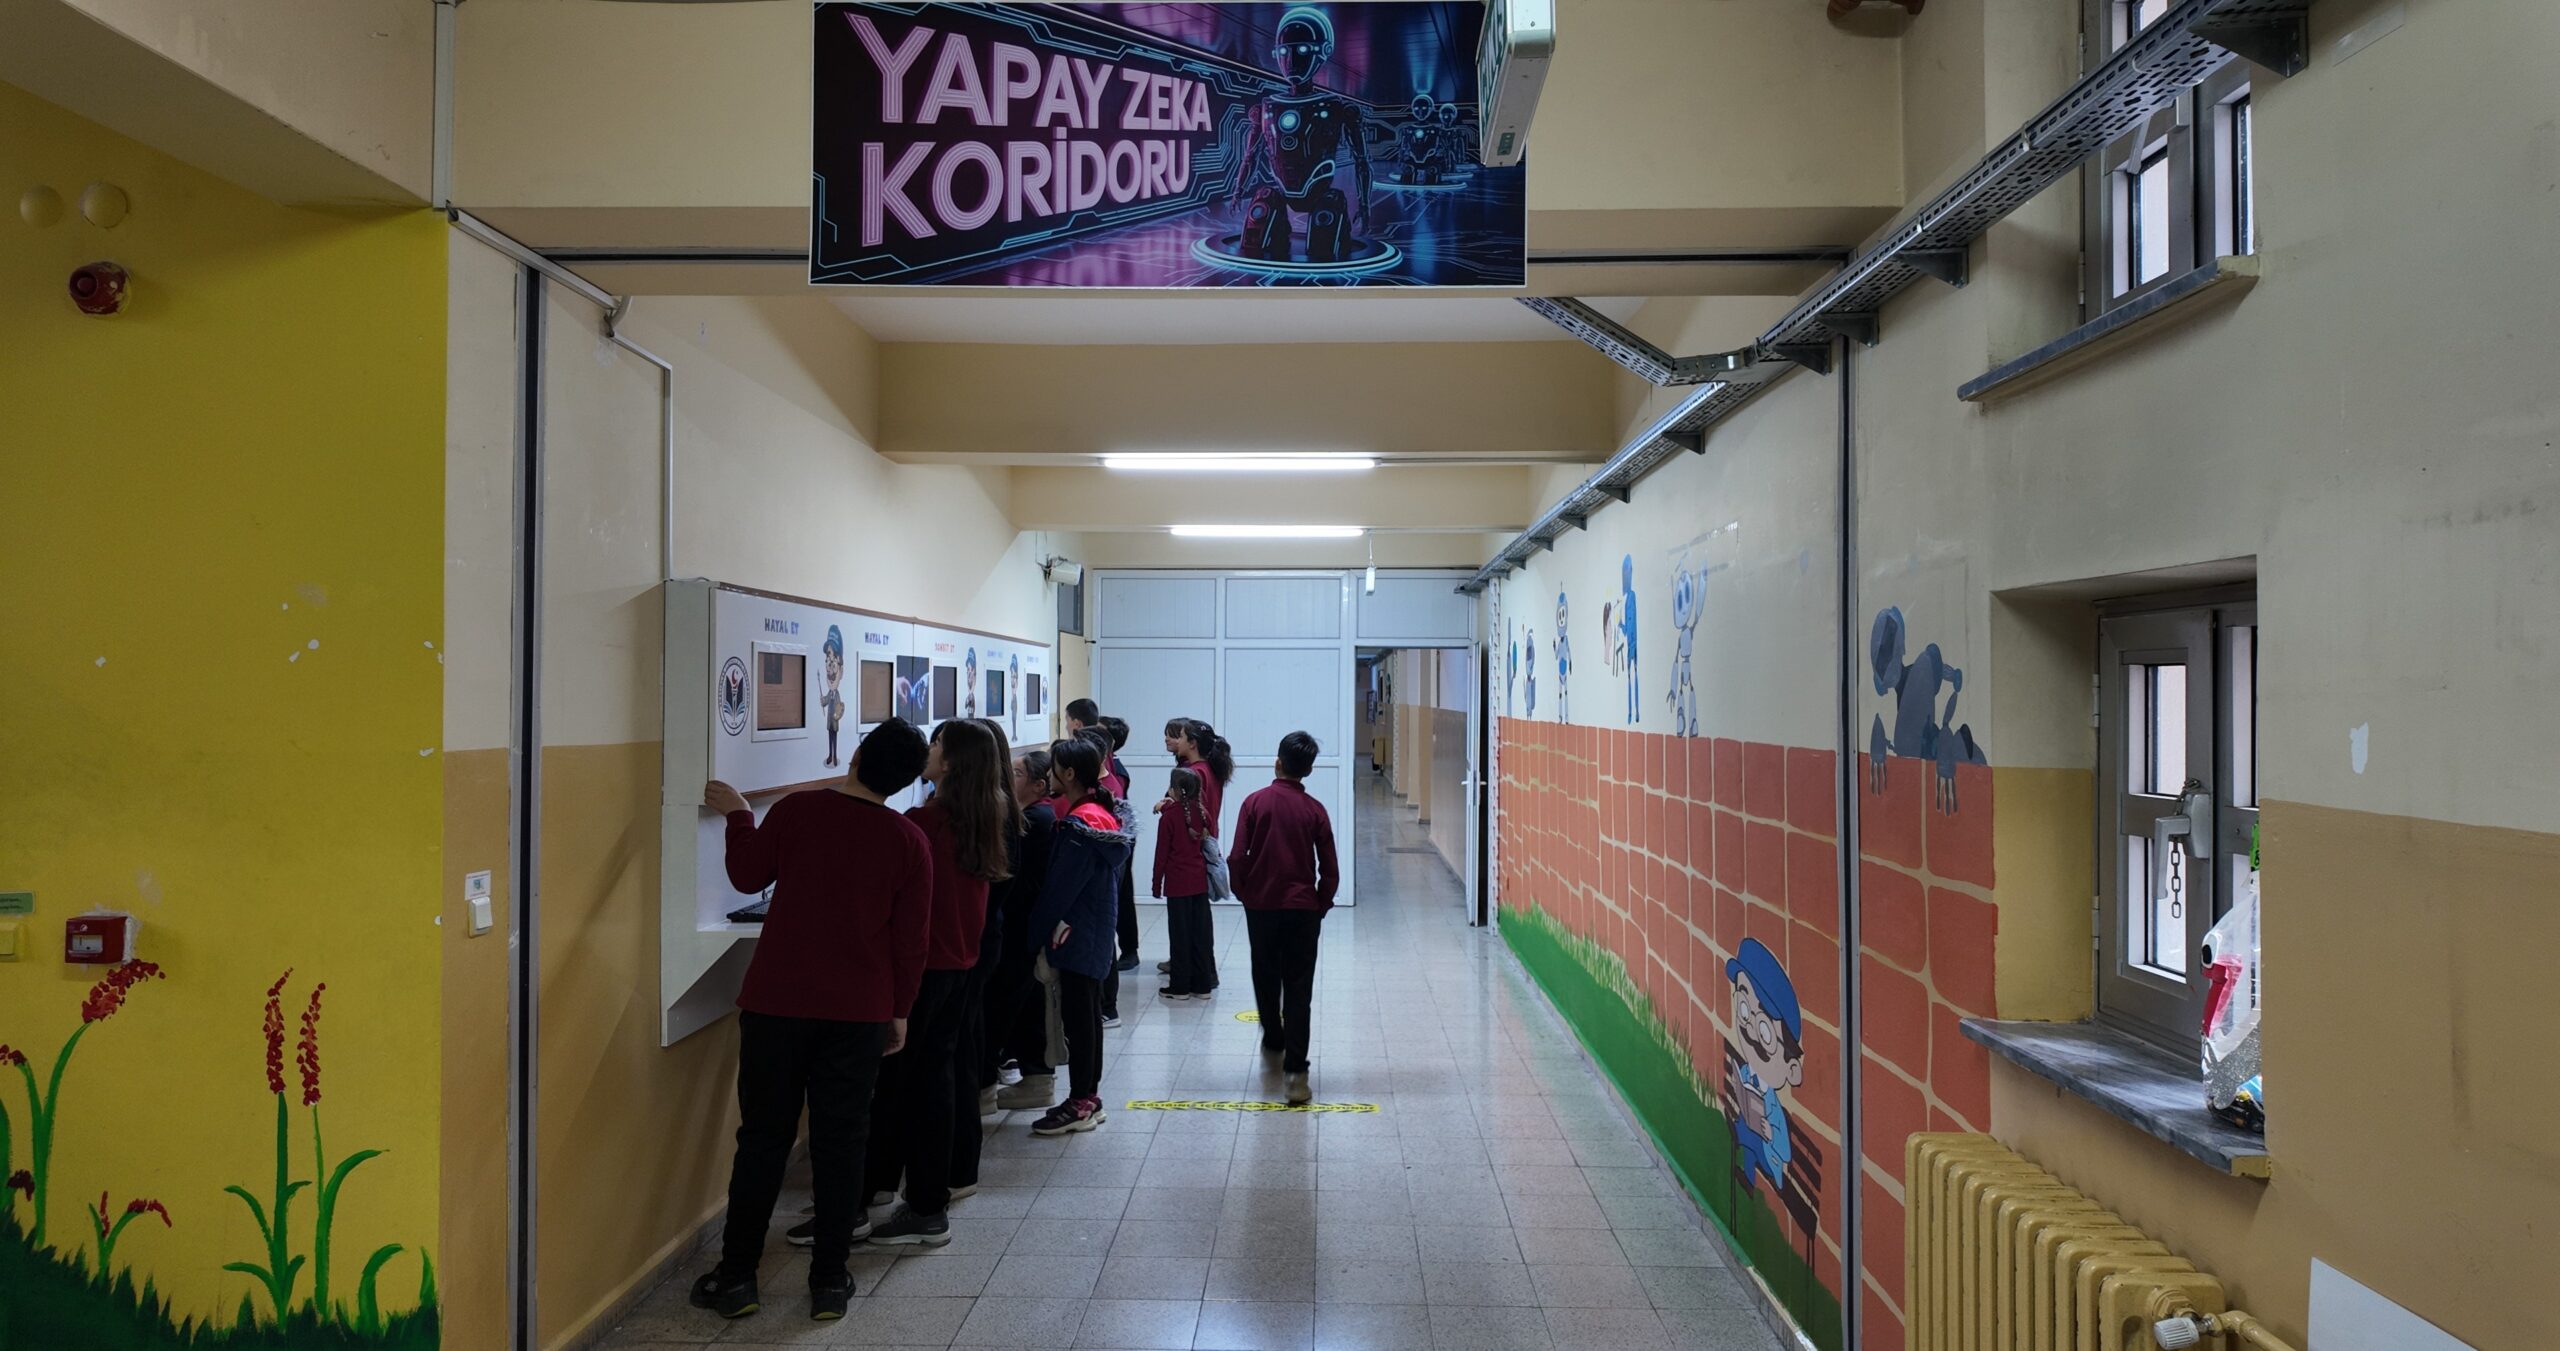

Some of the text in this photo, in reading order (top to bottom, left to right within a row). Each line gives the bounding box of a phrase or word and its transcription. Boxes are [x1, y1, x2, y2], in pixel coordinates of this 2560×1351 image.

[844, 11, 1213, 132] YAPAY ZEKA
[861, 126, 1191, 247] KORİDORU
[764, 617, 800, 635] HAYAL ET
[864, 631, 882, 644] HAYAL
